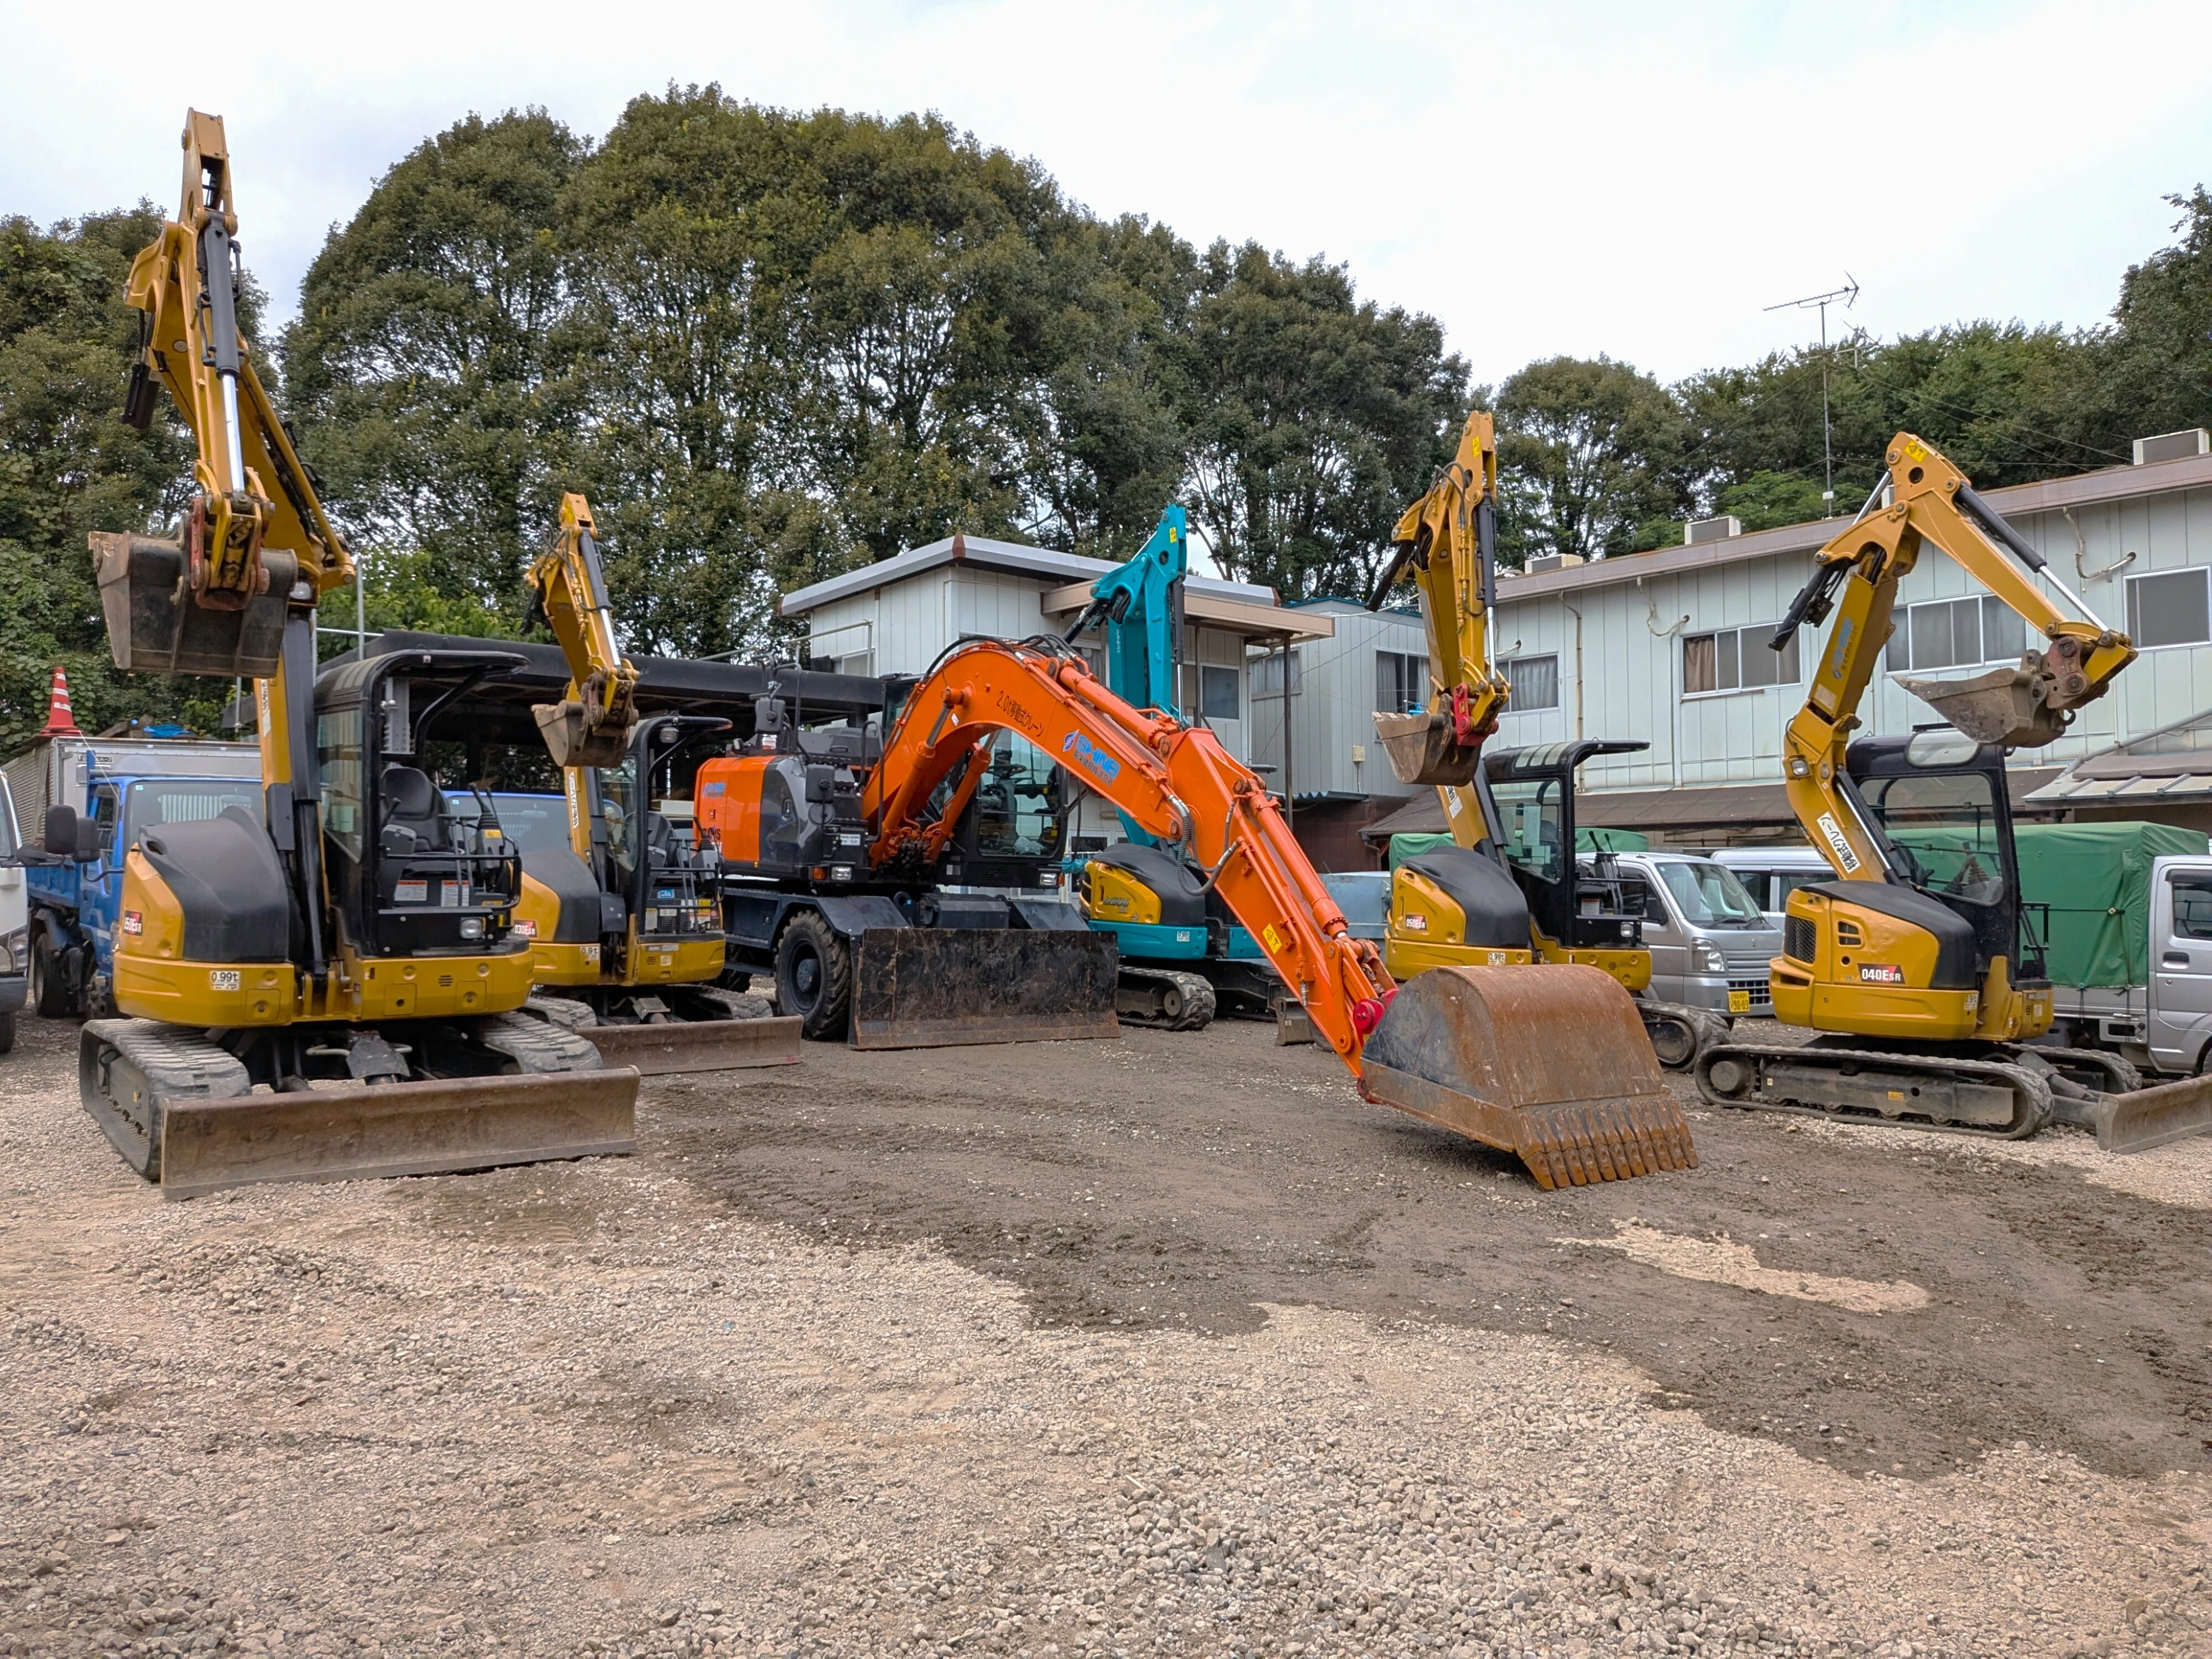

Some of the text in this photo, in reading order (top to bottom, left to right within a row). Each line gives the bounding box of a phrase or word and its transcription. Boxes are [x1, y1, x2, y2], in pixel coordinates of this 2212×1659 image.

[1820, 817, 1858, 870] 移動式クレーン
[211, 972, 238, 982] 0.99t
[1861, 968, 1901, 982] 040ESR
